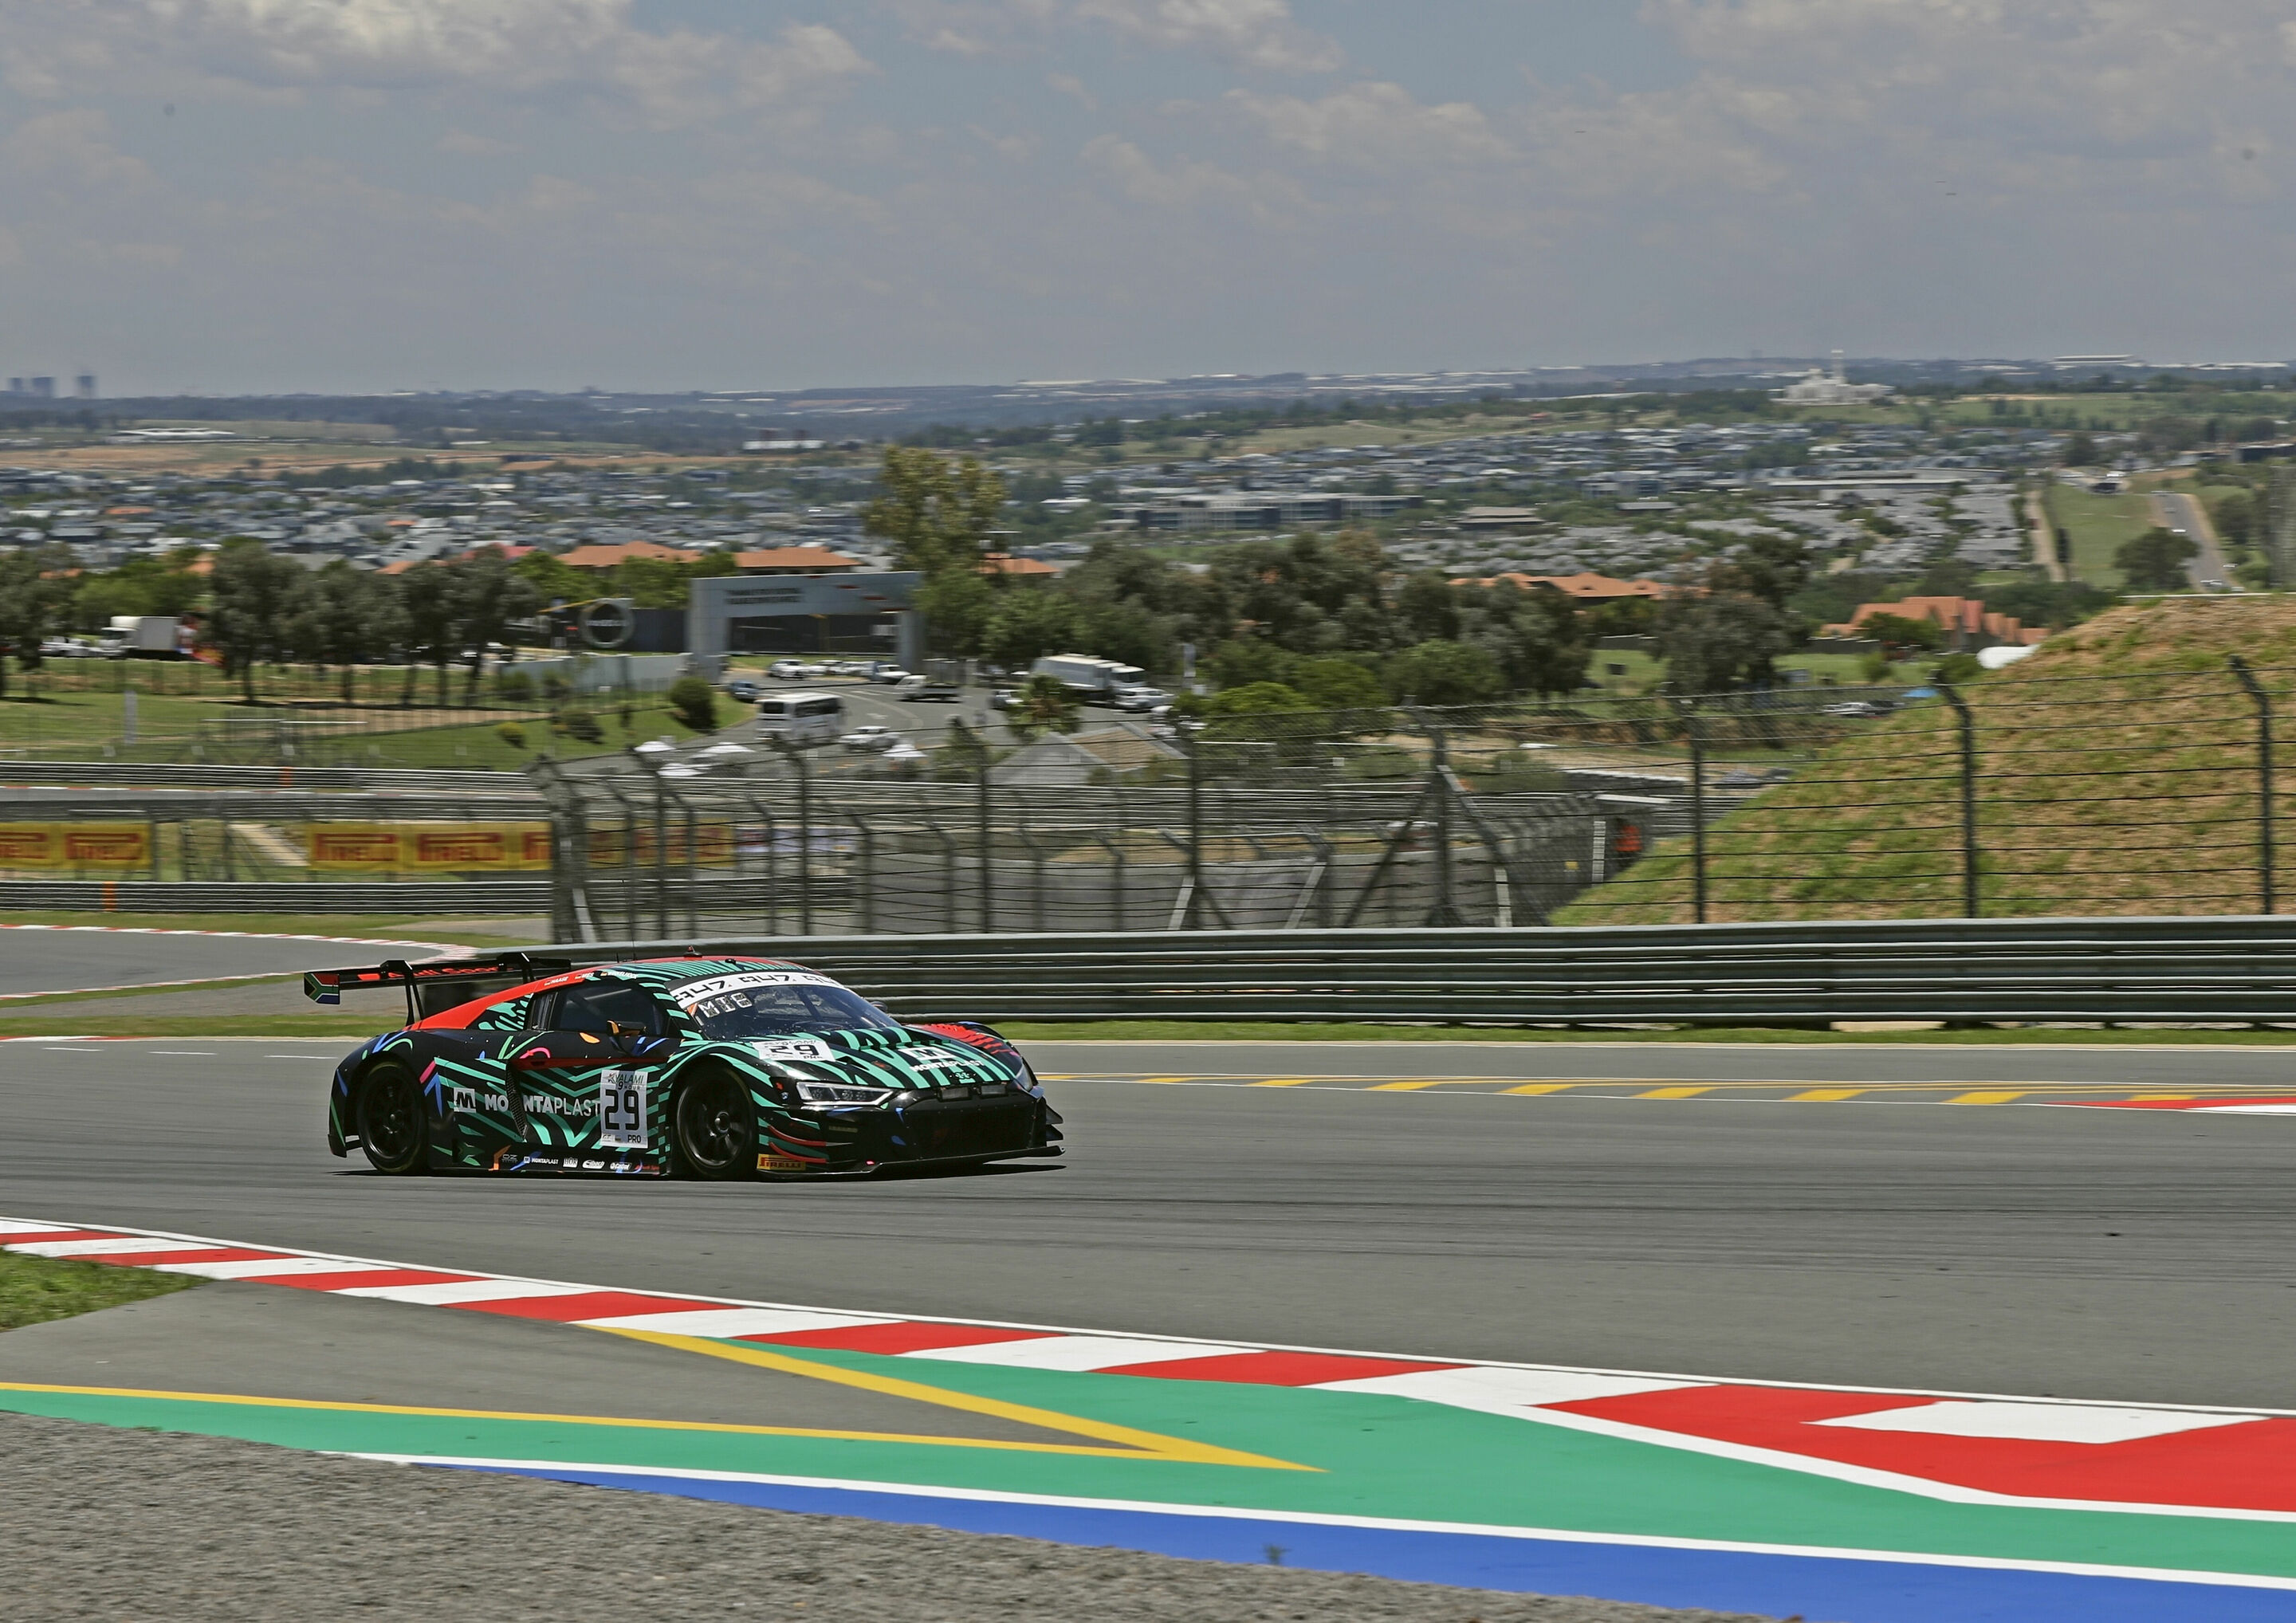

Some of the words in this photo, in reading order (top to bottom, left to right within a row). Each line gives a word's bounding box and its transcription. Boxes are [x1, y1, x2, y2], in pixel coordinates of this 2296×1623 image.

[765, 1044, 820, 1056] 29
[909, 1060, 985, 1072] MONTAPLAST
[485, 1093, 601, 1117] MONTAPLAST
[605, 1089, 639, 1130] 29
[627, 1134, 642, 1143] PRO
[760, 1157, 803, 1169] PIRELLI
